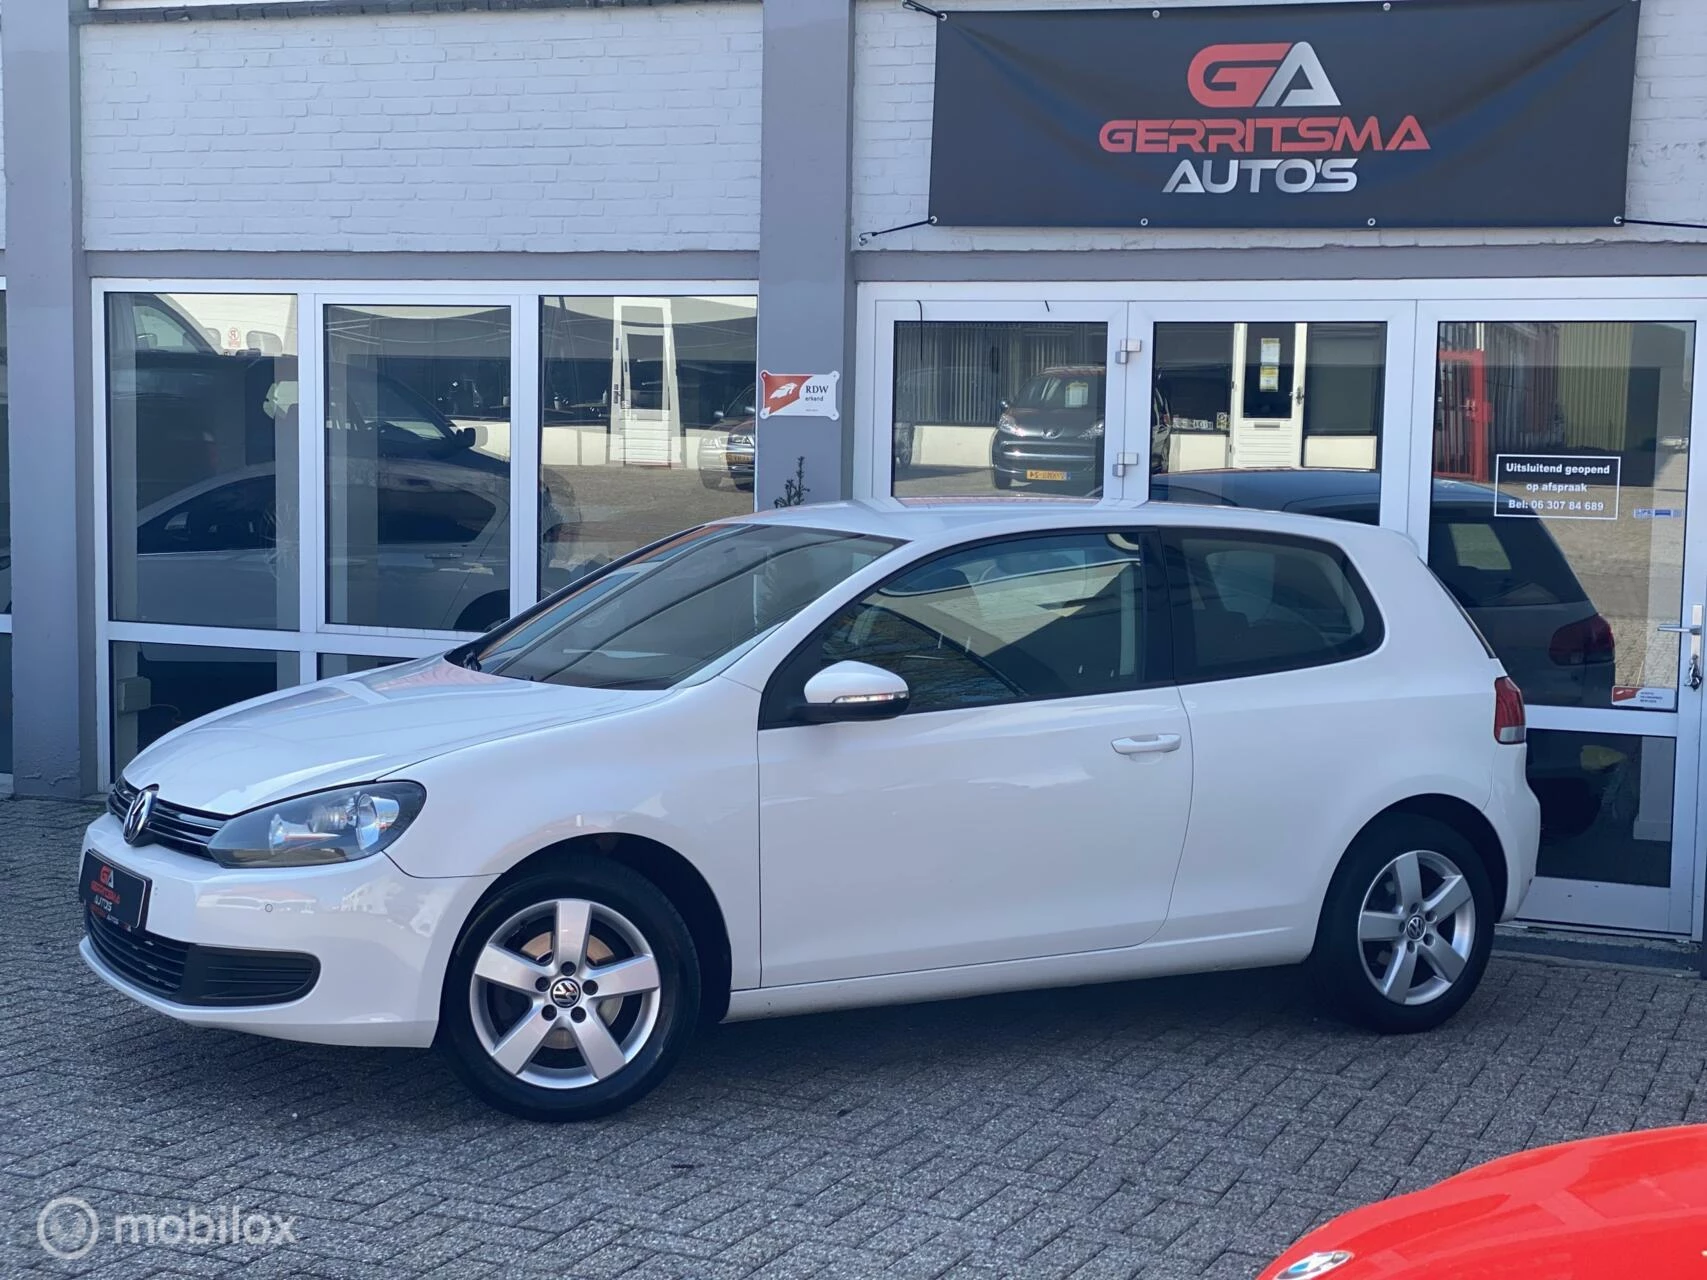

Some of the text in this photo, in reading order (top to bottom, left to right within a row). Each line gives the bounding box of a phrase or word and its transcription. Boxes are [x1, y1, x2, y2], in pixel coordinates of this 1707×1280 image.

[1187, 41, 1341, 107] GA
[1099, 115, 1431, 153] GERRITSMA
[1161, 158, 1358, 193] AUTO'S
[805, 385, 829, 394] RDW
[1506, 463, 1610, 476] Uitsluitend geopend
[1526, 482, 1588, 493] op afspraak
[1508, 499, 1604, 511] Bel: 06 307 84 689
